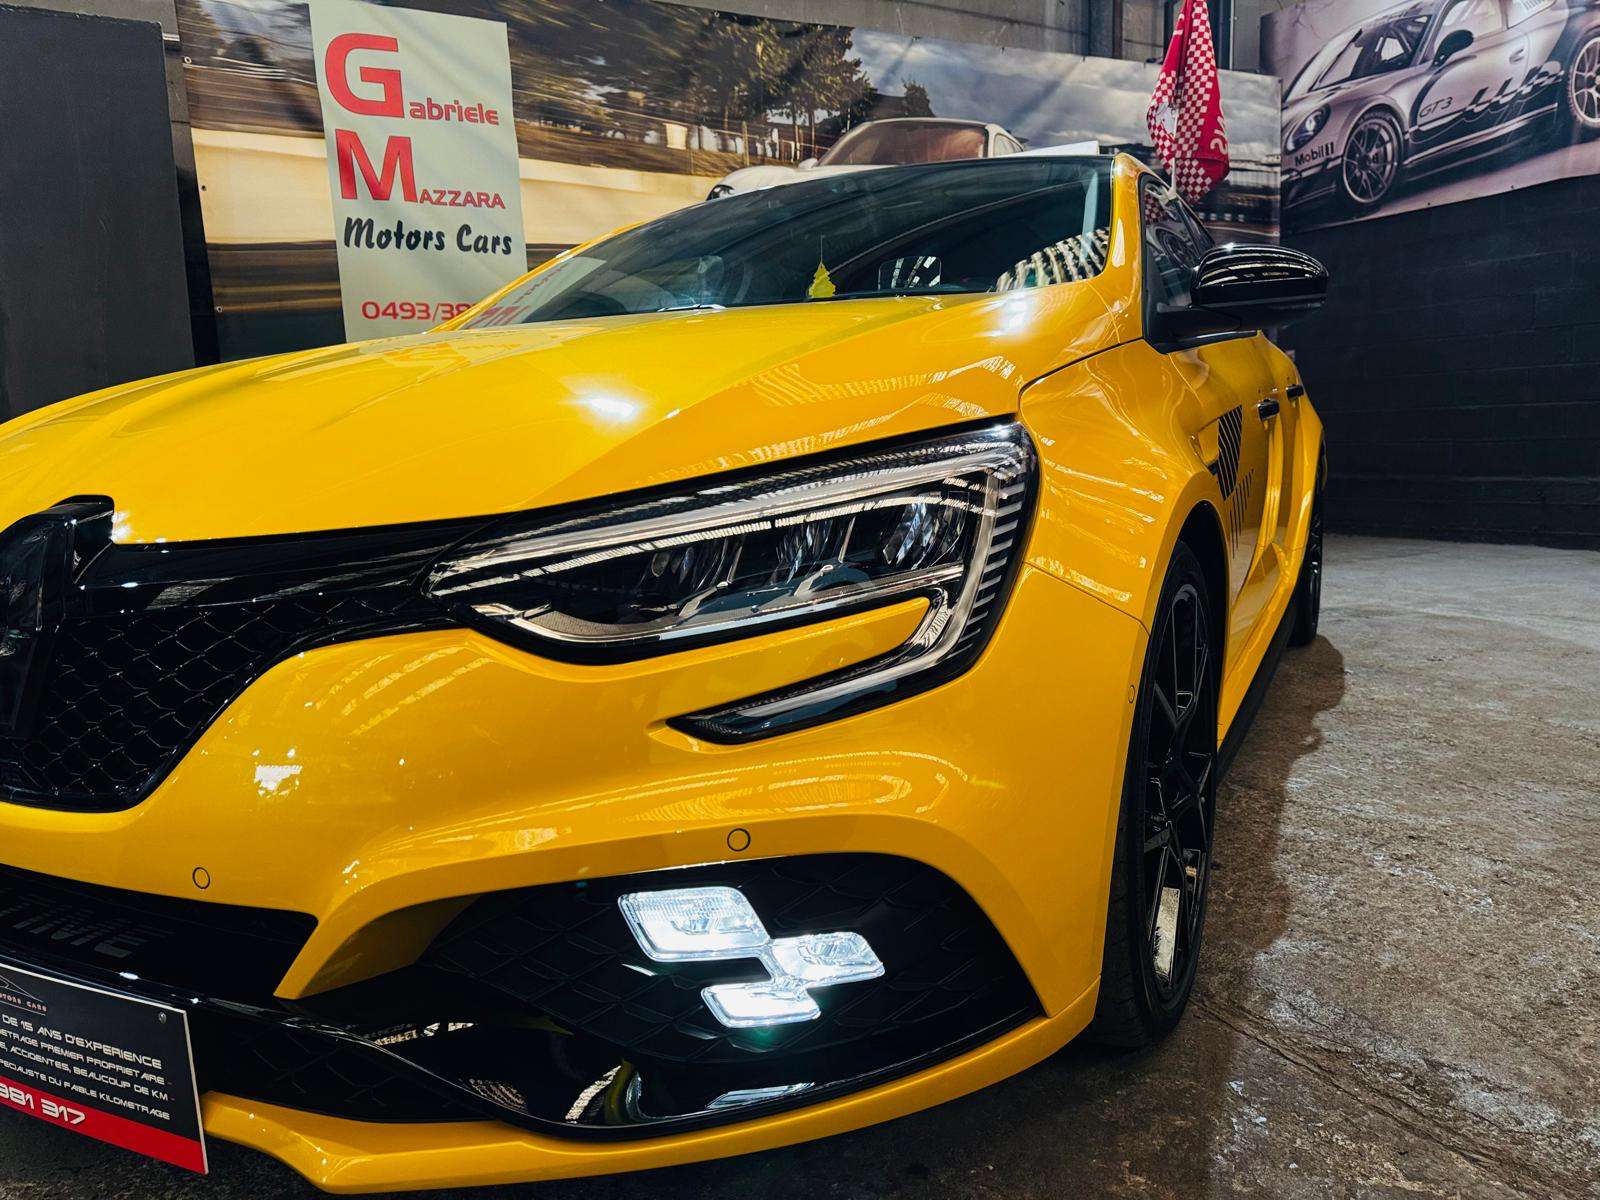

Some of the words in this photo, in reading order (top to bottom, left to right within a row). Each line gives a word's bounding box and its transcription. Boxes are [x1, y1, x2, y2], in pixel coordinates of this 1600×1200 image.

[1418, 96, 1453, 118] GT3
[334, 128, 506, 209] MAZZARA
[343, 216, 446, 251] Motors
[456, 223, 512, 255] Cars
[361, 301, 478, 322] 0493/38
[2, 1014, 19, 1027] DE
[37, 1026, 62, 1041] ANS
[65, 1033, 162, 1070] D'EXPERIENCE
[40, 1042, 85, 1062] PREMIER
[48, 1076, 62, 1086] DU
[98, 1092, 171, 1121] KILOMETRAGE
[73, 1066, 131, 1089] BEAUCOUP
[133, 1084, 150, 1096] DE
[151, 1089, 169, 1102] KM
[40, 1098, 86, 1125] 317
